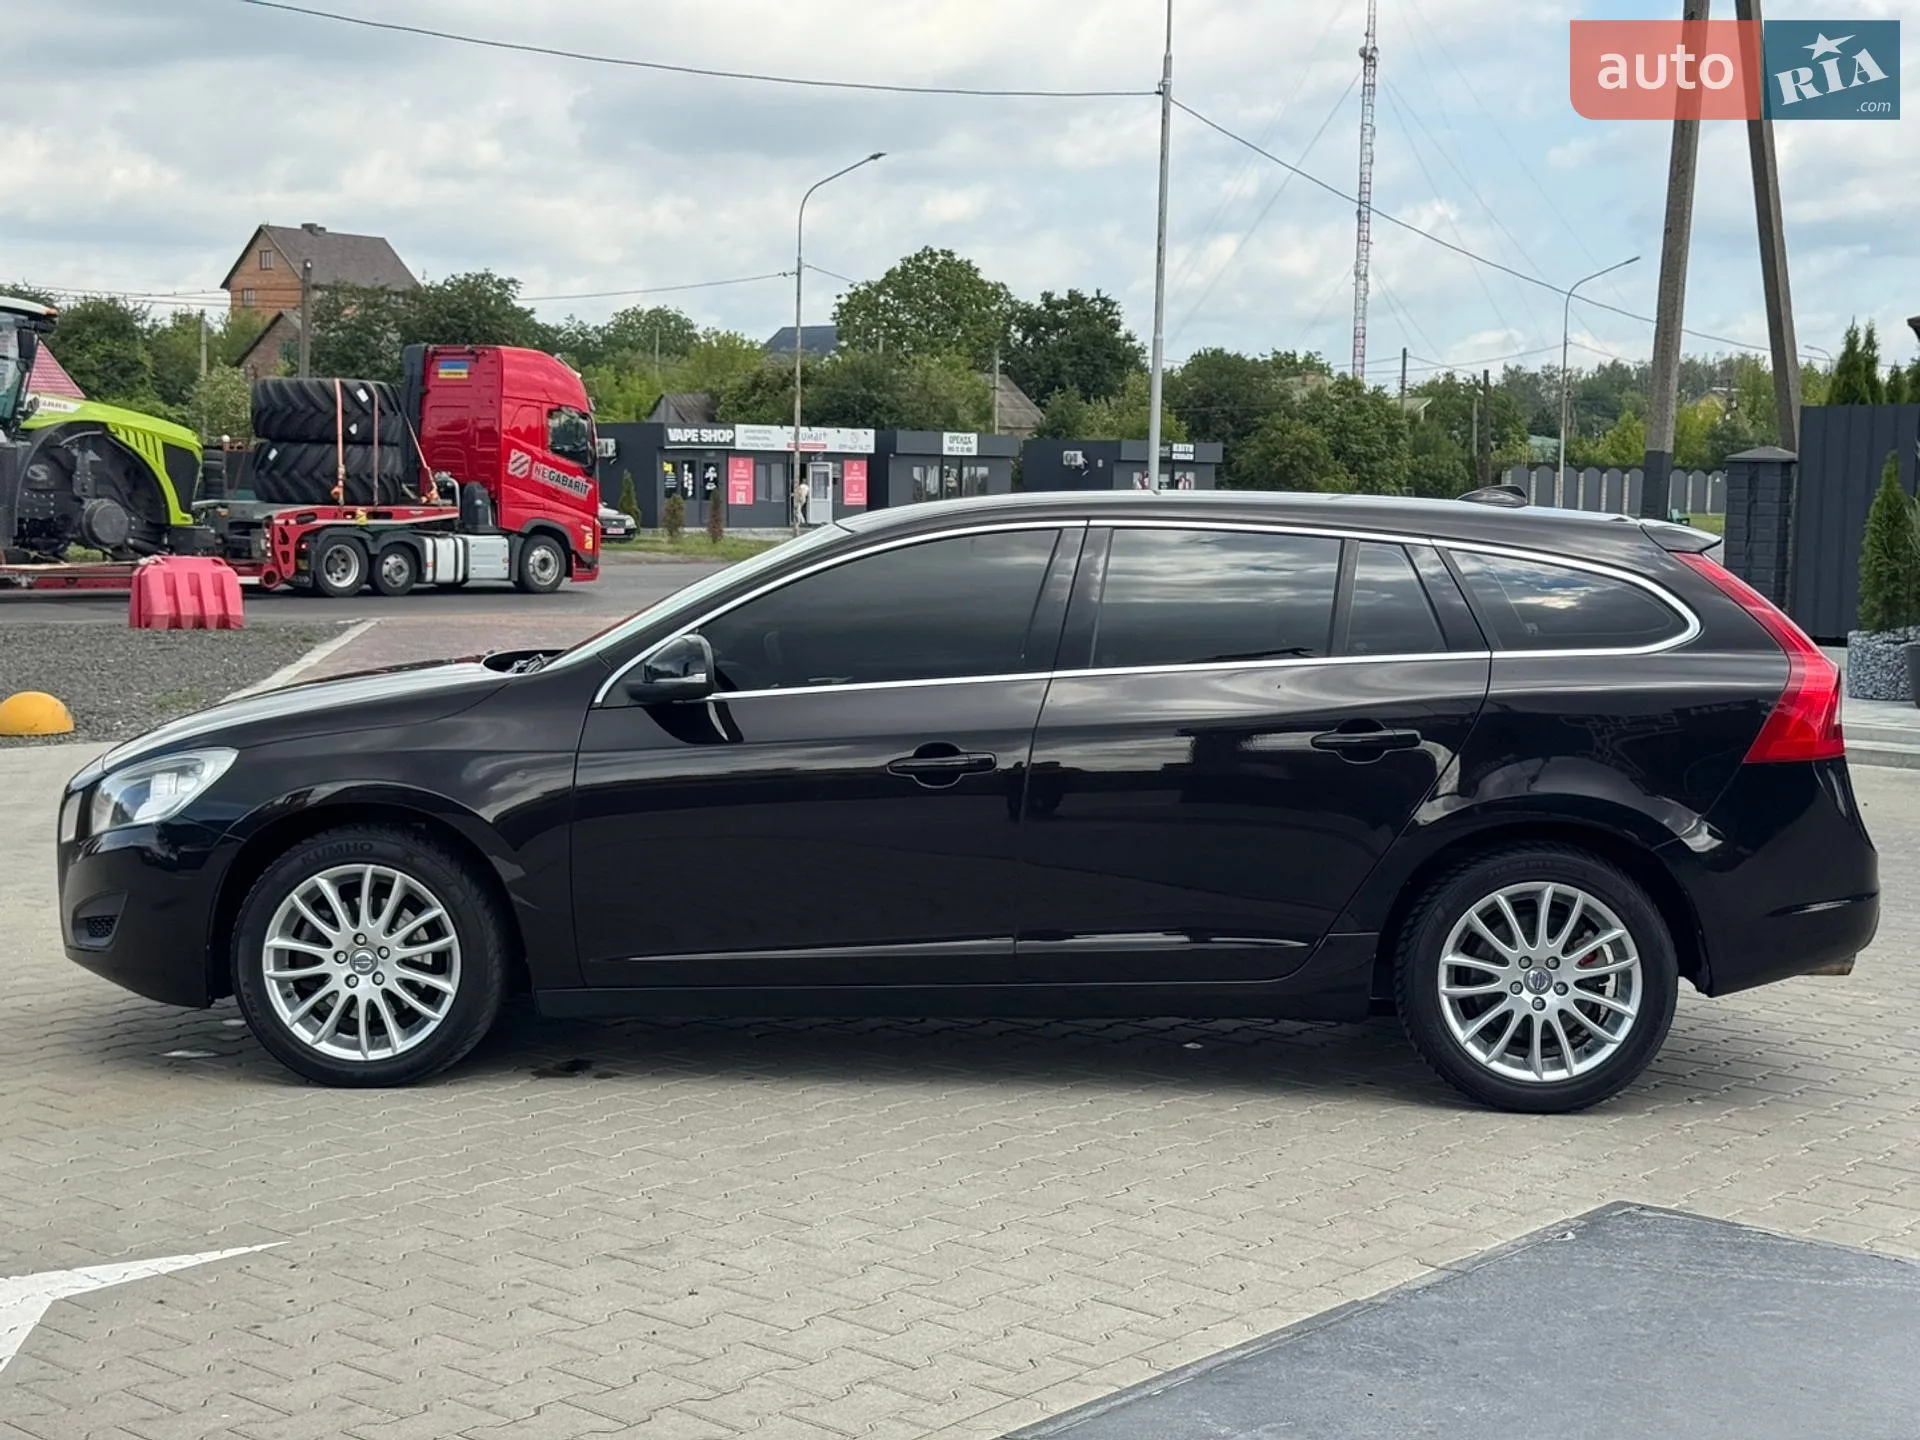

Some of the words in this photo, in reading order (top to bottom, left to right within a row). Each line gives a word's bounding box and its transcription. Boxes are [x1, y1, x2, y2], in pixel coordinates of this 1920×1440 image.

[667, 428, 699, 442] VAPE
[700, 428, 735, 443] SHOP
[534, 465, 590, 494] NEGABARIT
[301, 842, 374, 866] KUMHO
